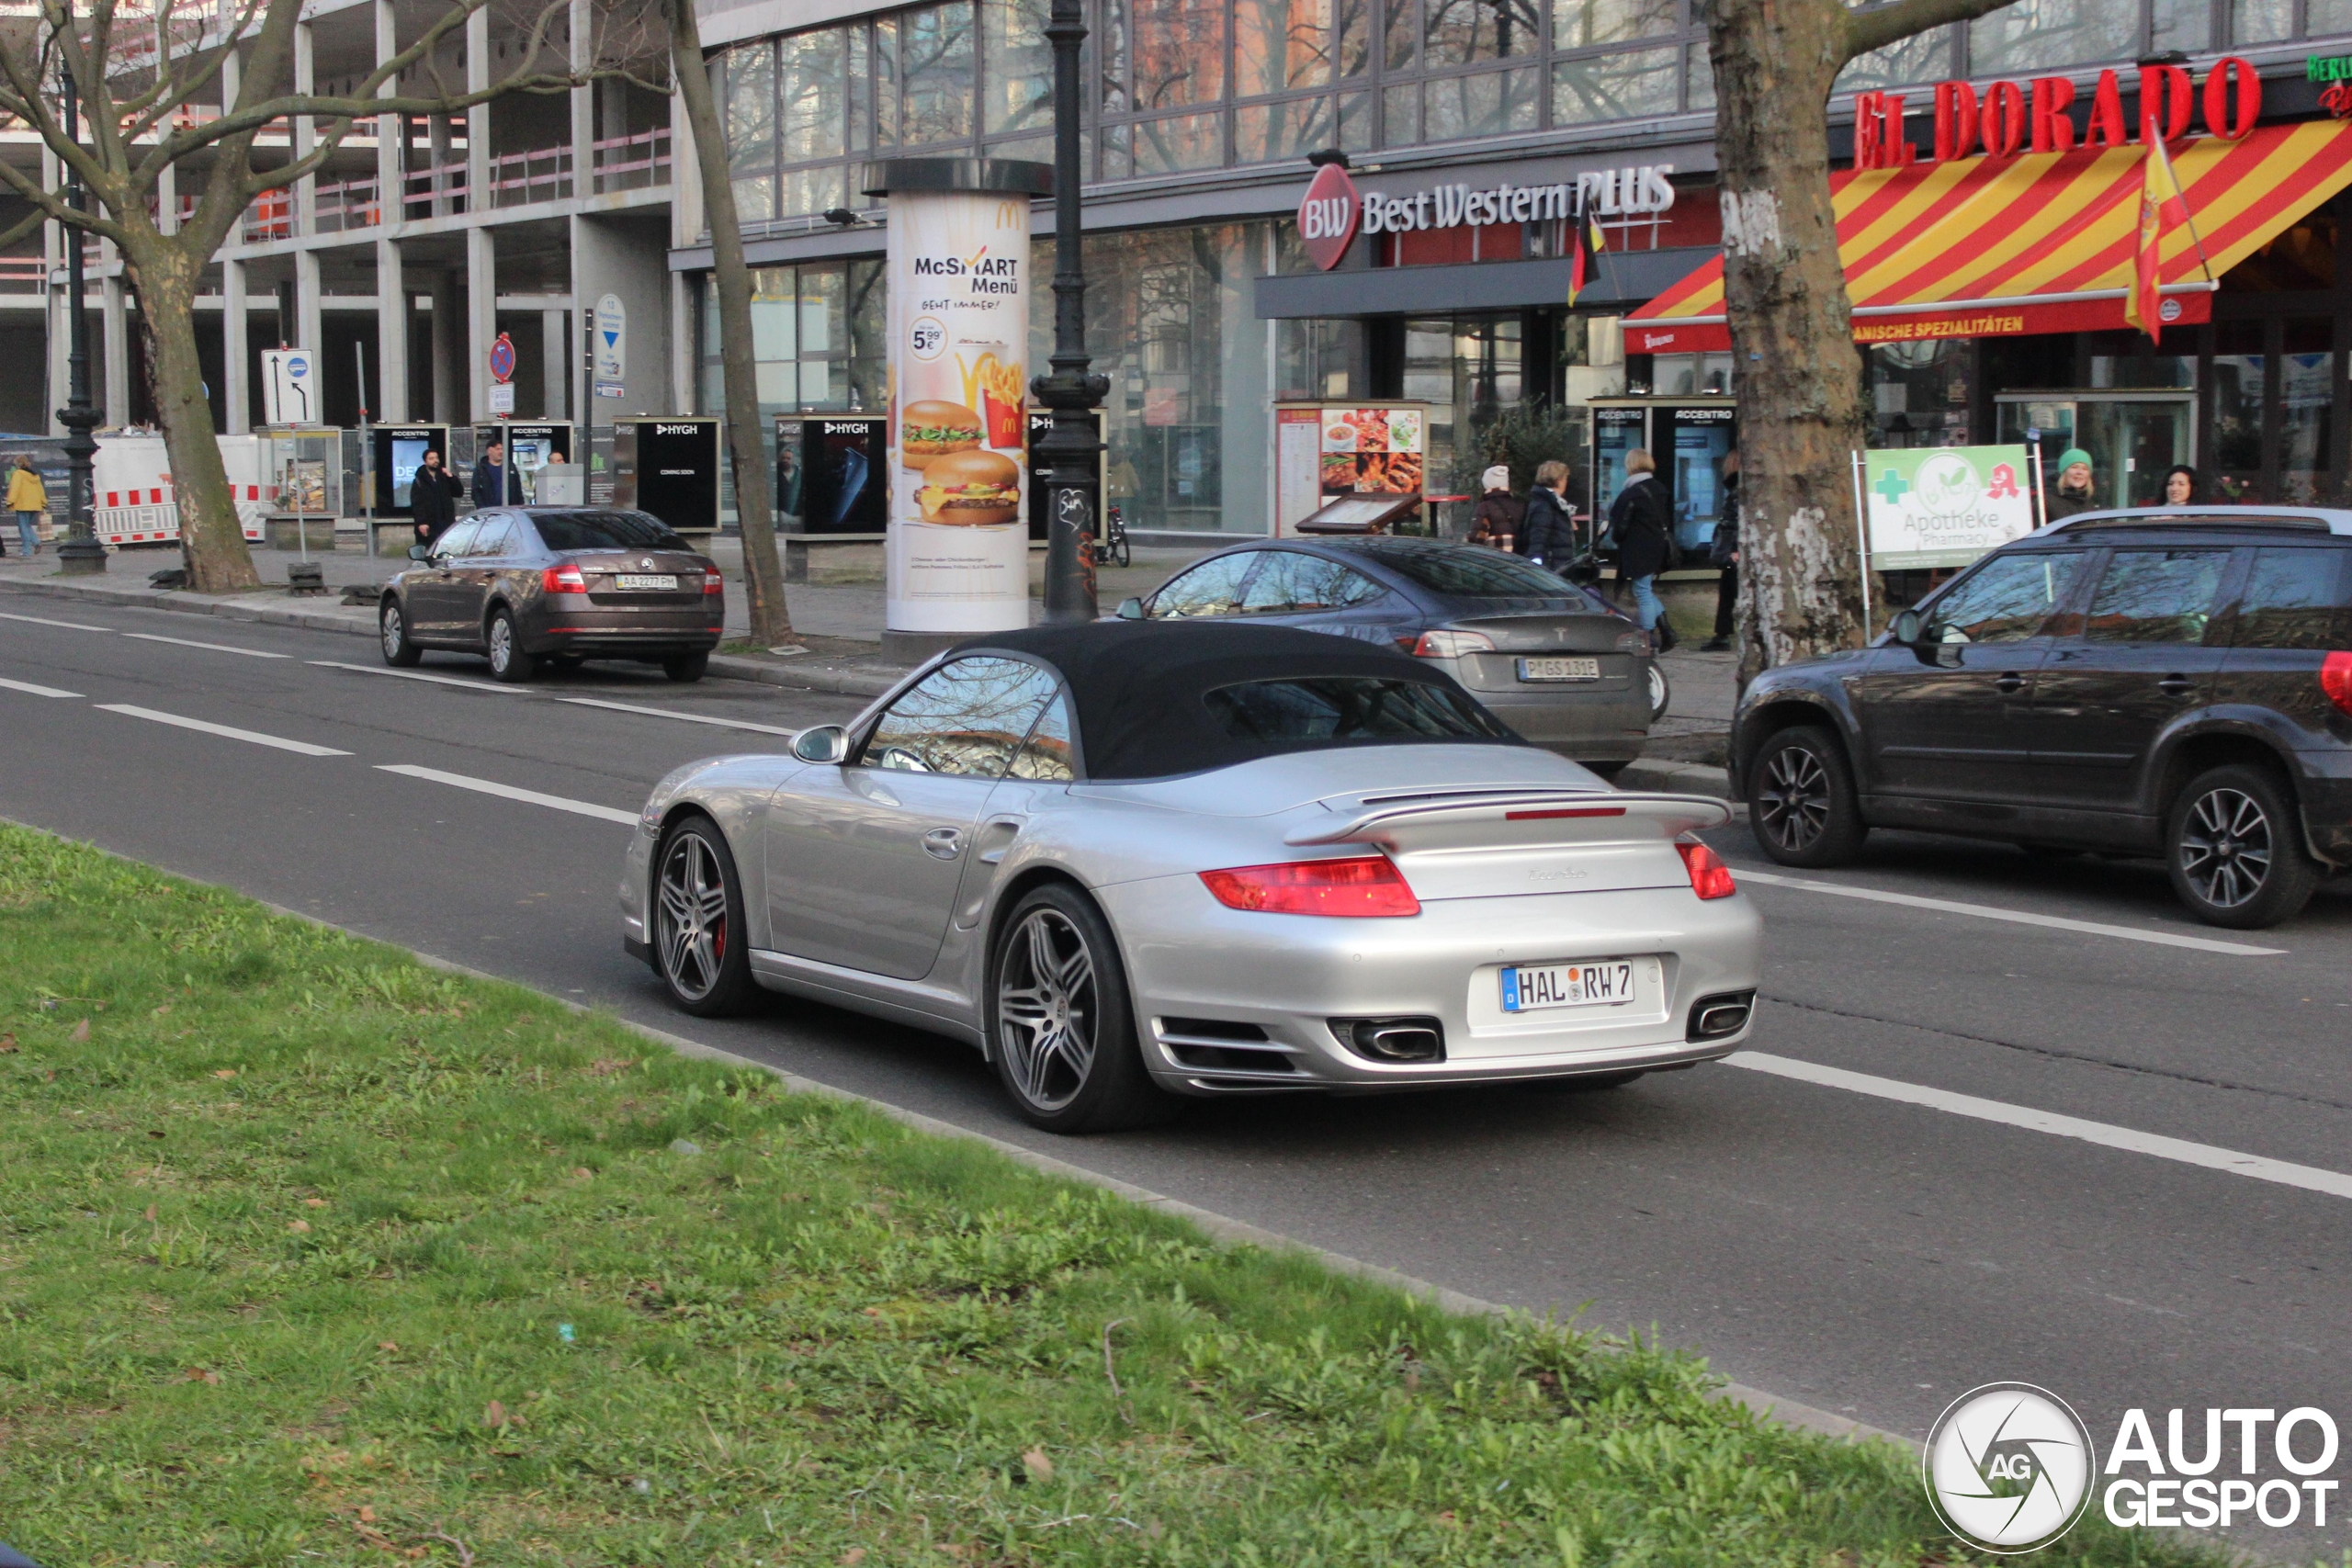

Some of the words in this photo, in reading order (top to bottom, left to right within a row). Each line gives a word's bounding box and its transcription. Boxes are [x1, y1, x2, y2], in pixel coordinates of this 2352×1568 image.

[1854, 92, 1917, 171] EL
[1931, 57, 2263, 162] DORADO
[1363, 191, 1430, 235] Best
[1434, 183, 1571, 229] Western
[1577, 164, 1675, 218] PLUS
[1305, 197, 1350, 240] BW
[972, 278, 1018, 295] Menü
[922, 299, 951, 310] GEHT
[954, 300, 1001, 310] IMMER!
[1853, 322, 1913, 341] ANISCHE
[1915, 315, 2023, 337] SPEZIALITÄTEN
[914, 331, 925, 350] 5
[1675, 410, 1733, 420] ACCENTRO
[668, 424, 698, 435] HYGH
[836, 423, 869, 434] HYGH
[395, 466, 418, 477] DE
[1904, 509, 1999, 536] Apotheke
[1923, 533, 1989, 547] Pharmacy
[624, 577, 638, 586] AA
[639, 577, 660, 587] 2277
[661, 577, 675, 587] PM
[1528, 661, 1535, 676] P
[1545, 660, 1562, 676] GS
[1565, 660, 1597, 676] 131E
[1519, 971, 1566, 1004] HAL
[1583, 966, 1611, 998] RW
[1618, 964, 1630, 996] 7
